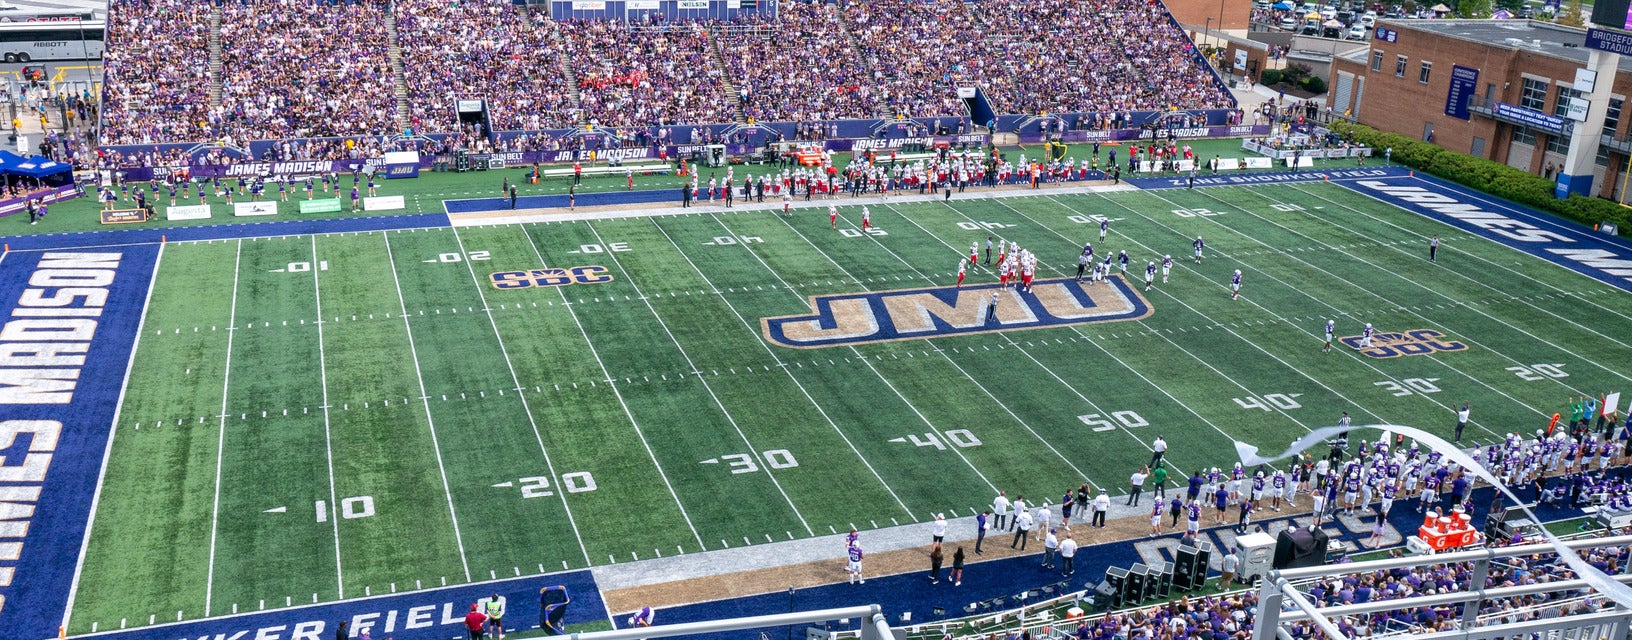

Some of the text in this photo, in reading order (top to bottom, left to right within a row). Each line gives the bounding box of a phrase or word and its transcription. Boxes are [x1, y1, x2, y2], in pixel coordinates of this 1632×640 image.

[852, 139, 887, 150] JAMES
[225, 161, 333, 175] JAMES MADISON
[1331, 169, 1388, 178] FIELD
[1356, 180, 1579, 243] JAMES
[489, 265, 614, 289] SBC
[765, 275, 1150, 347] JMU
[1505, 363, 1570, 381] 20
[1373, 377, 1442, 397] 30
[1232, 393, 1302, 411] 40
[1077, 410, 1150, 432] 50
[907, 428, 983, 450] 40
[721, 449, 799, 475] 30
[518, 471, 598, 499] 20
[315, 495, 376, 523] 10
[1436, 536, 1446, 548] G
[1461, 532, 1471, 543] G
